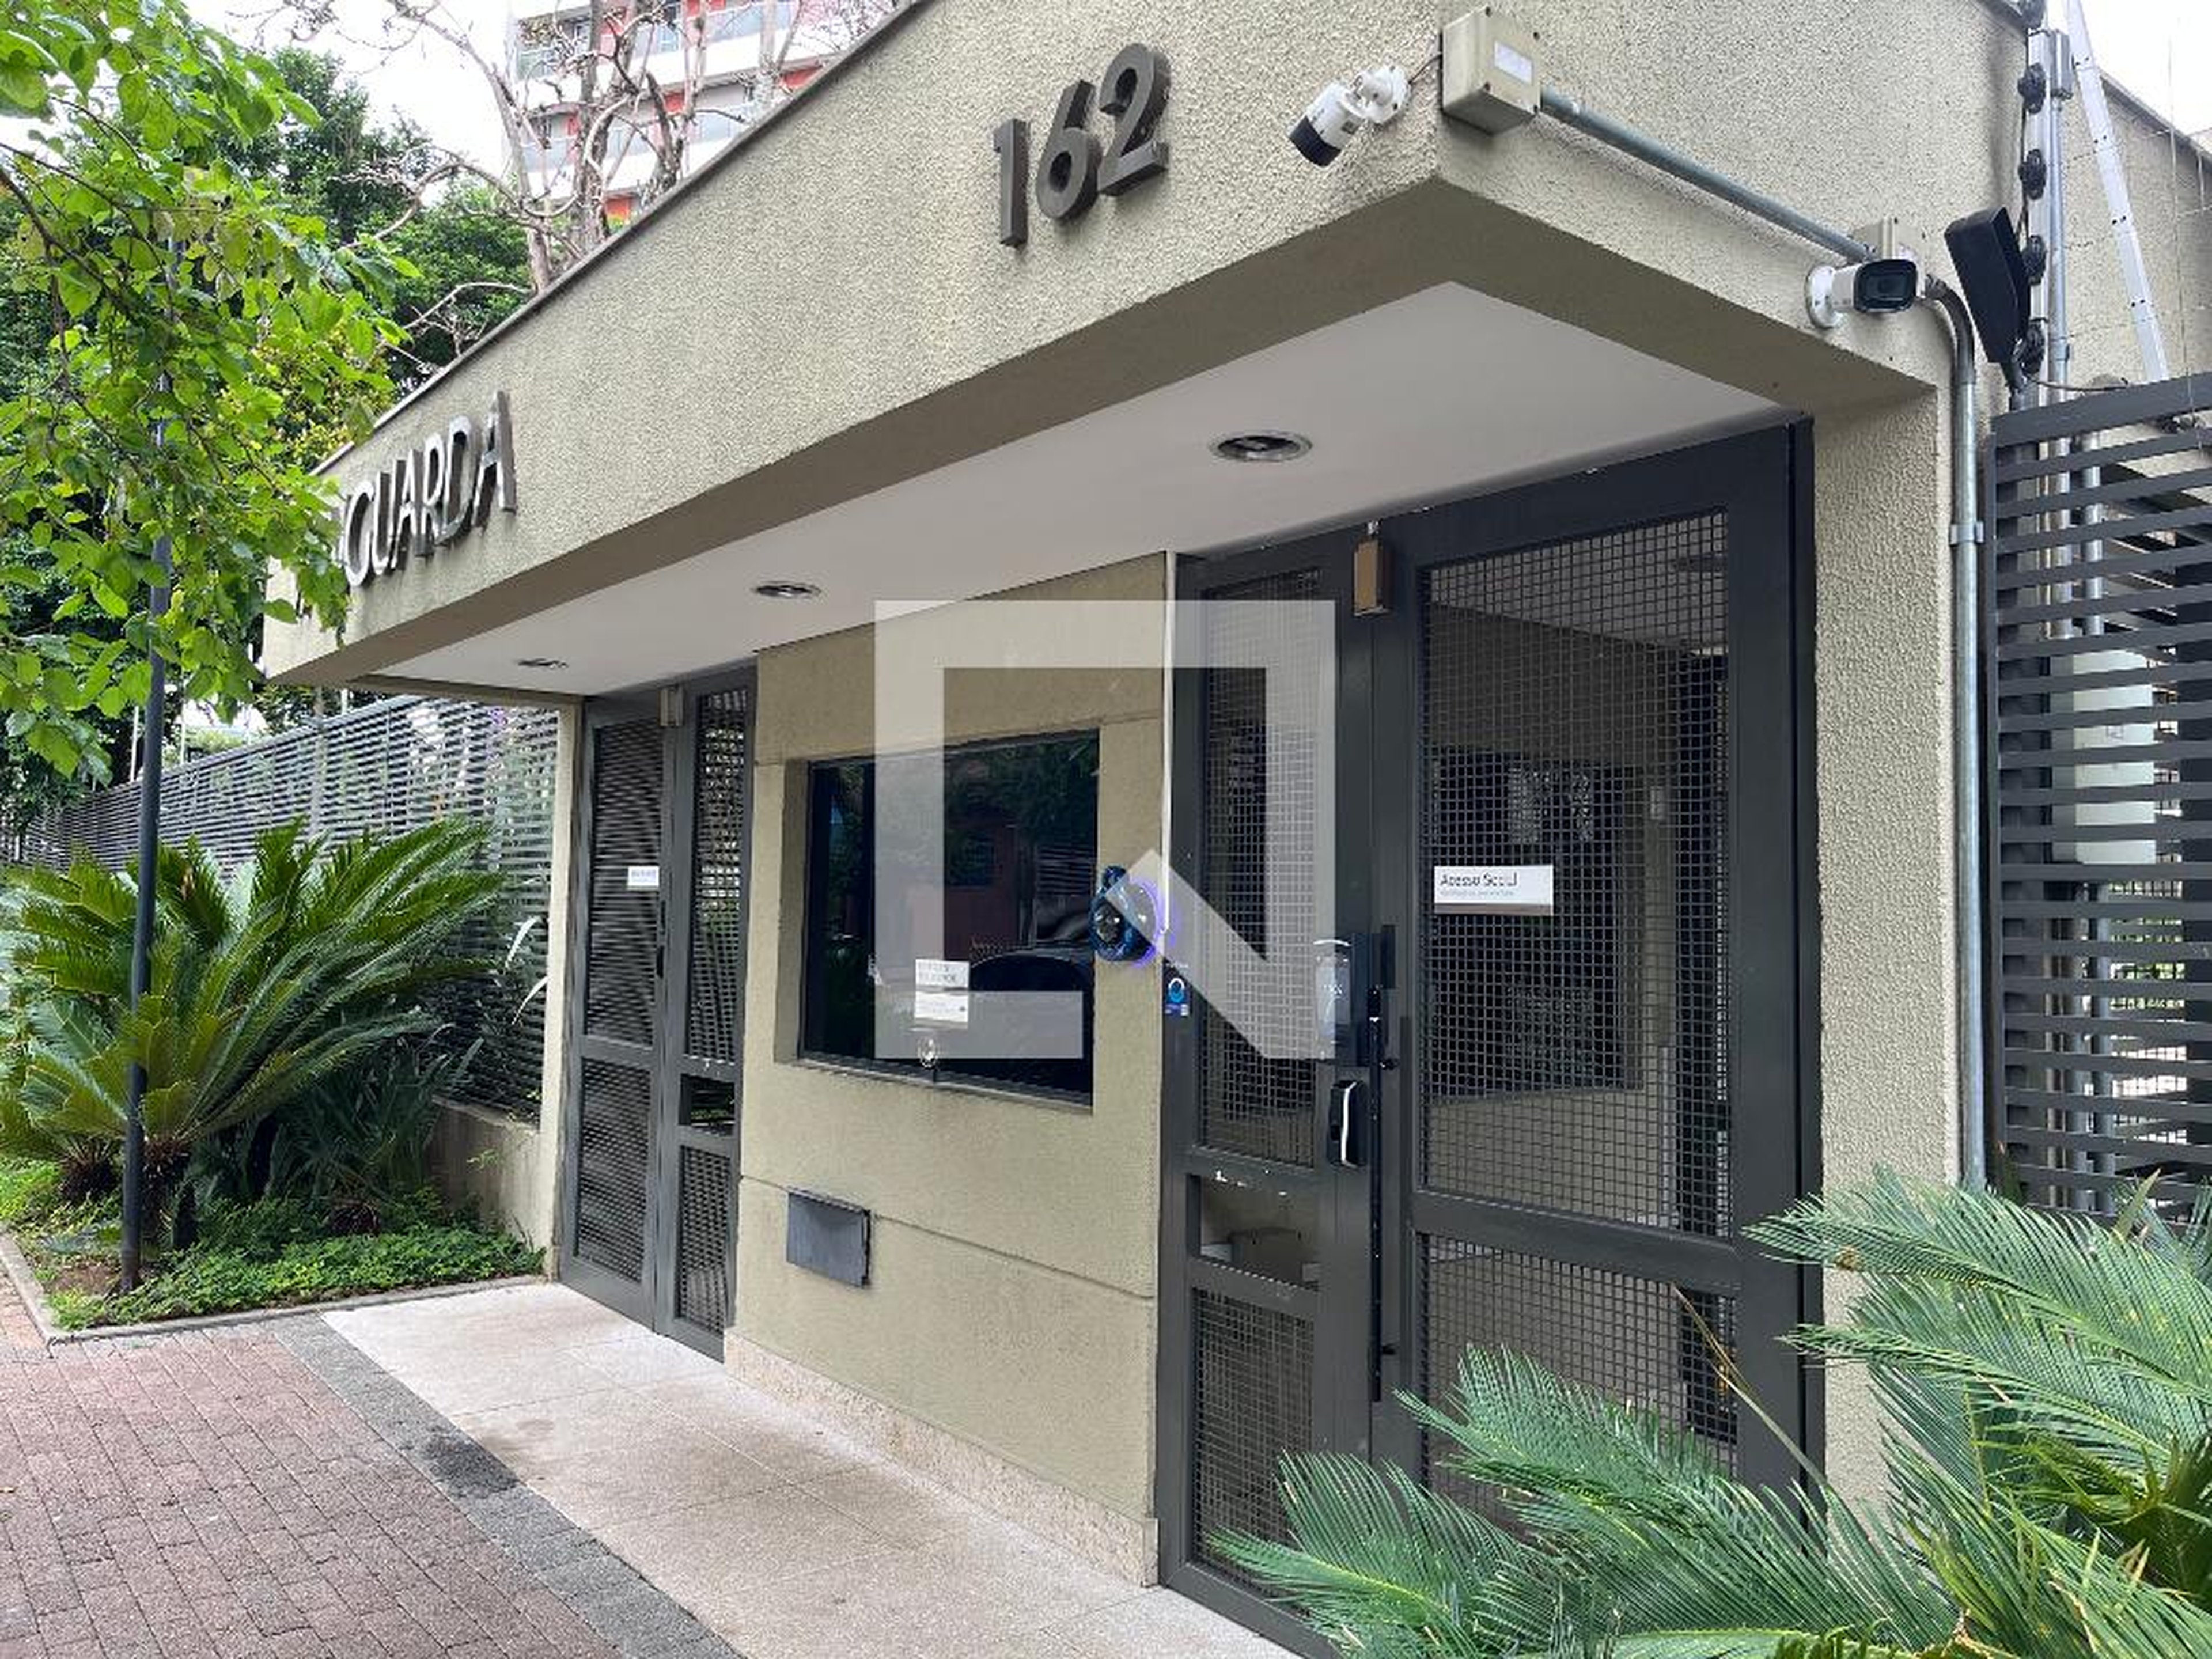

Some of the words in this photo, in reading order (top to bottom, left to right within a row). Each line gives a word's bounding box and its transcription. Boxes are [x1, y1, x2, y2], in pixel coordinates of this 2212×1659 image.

[994, 43, 1171, 248] 162
[328, 389, 517, 590] GUARDA
[1483, 872, 1518, 887] Socl
